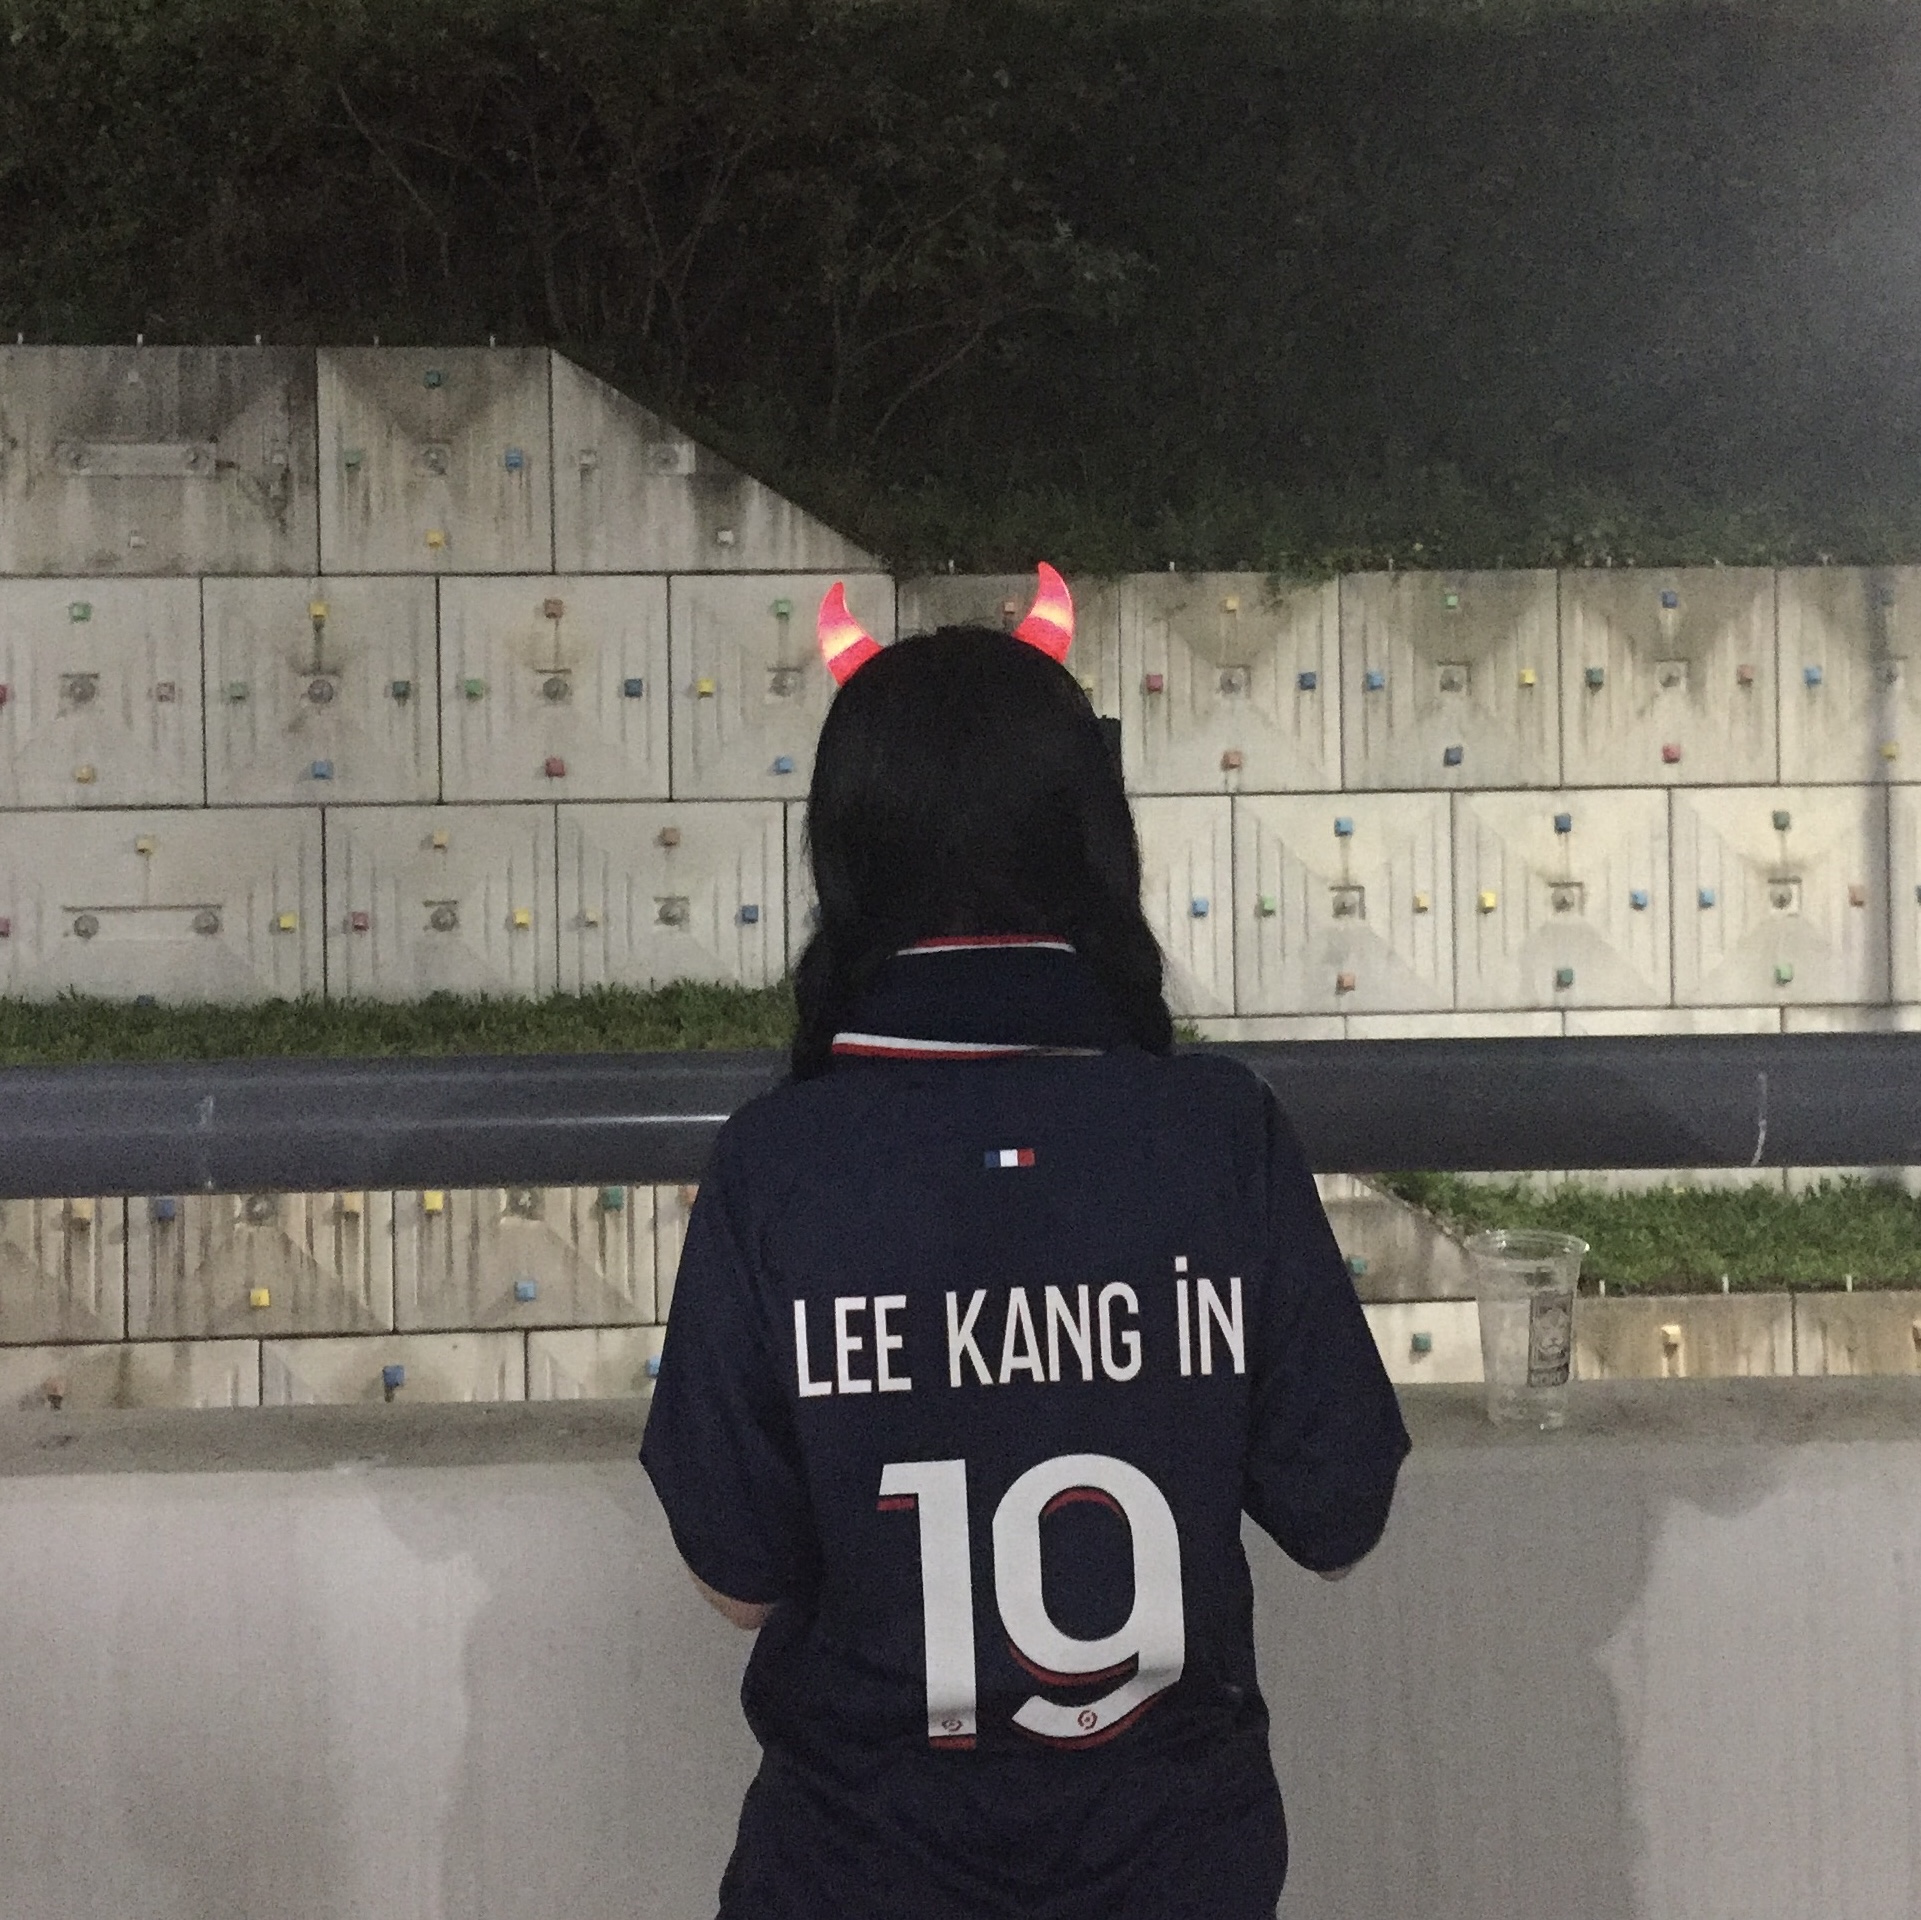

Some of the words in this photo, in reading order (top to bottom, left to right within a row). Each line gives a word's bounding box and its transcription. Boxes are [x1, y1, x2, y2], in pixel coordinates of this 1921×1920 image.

[793, 1294, 913, 1399] LEE
[945, 1281, 1143, 1389] KANG
[879, 1453, 1187, 1749] 19
